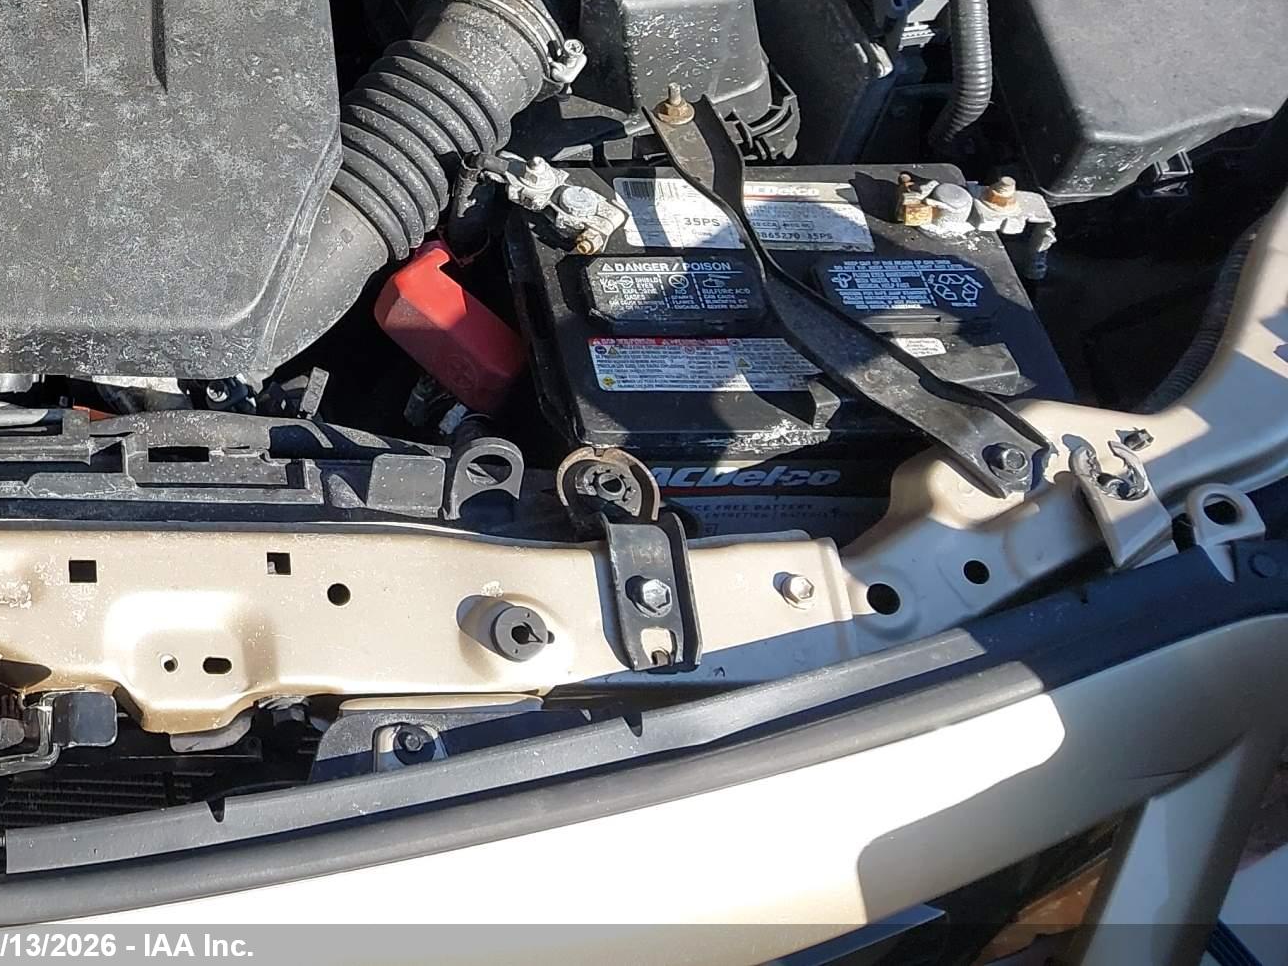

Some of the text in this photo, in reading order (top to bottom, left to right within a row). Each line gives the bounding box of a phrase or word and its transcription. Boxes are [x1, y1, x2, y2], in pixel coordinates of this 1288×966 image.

[683, 217, 721, 227] 35PS
[614, 263, 670, 272] DANGER
[683, 262, 732, 271] POISON
